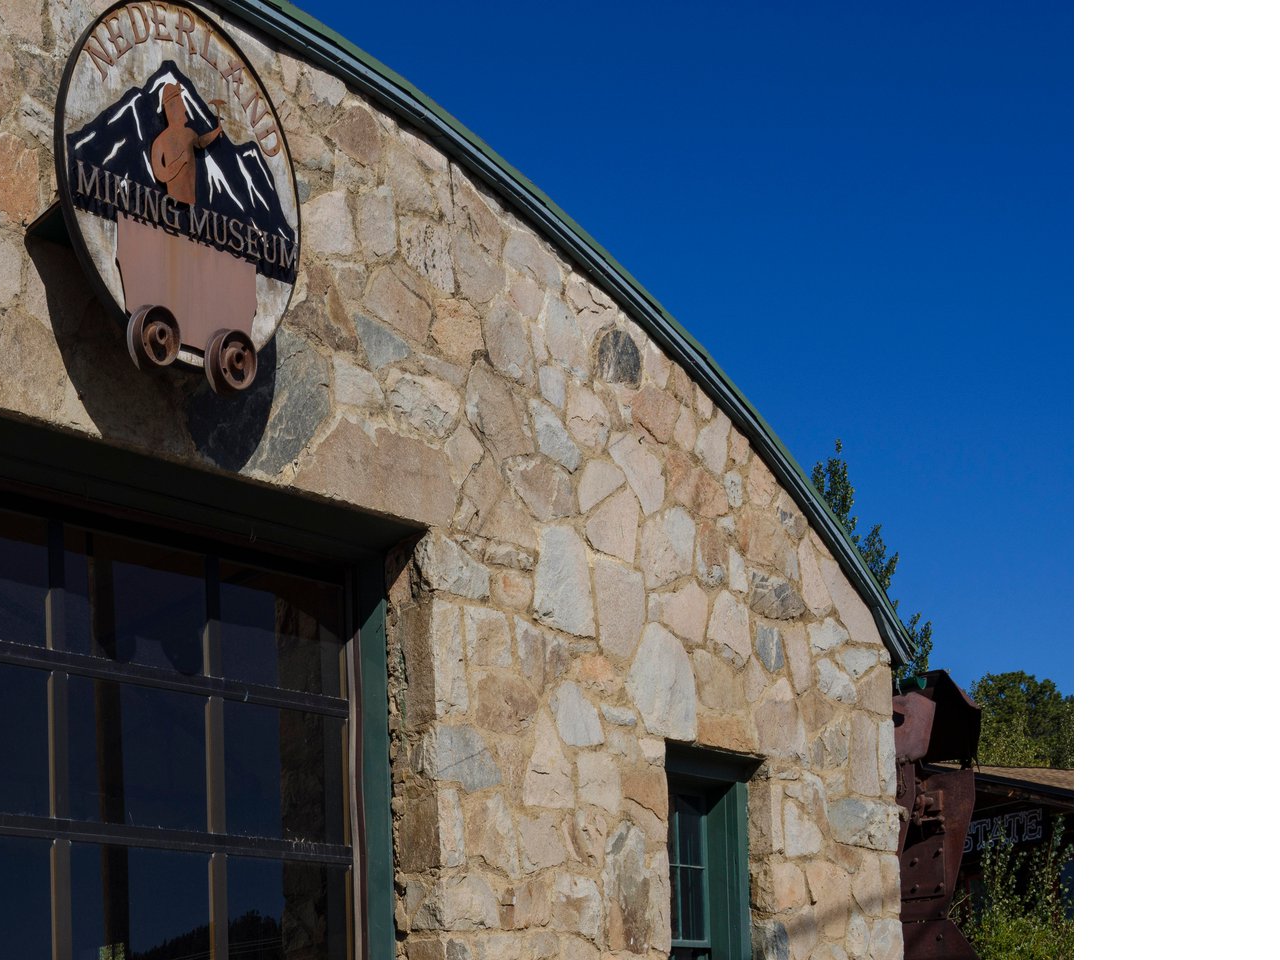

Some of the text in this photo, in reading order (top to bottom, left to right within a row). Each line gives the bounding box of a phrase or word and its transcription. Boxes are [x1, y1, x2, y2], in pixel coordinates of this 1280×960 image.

[82, 2, 281, 158] NEDERLAND
[75, 159, 299, 272] MINING MUSEUM
